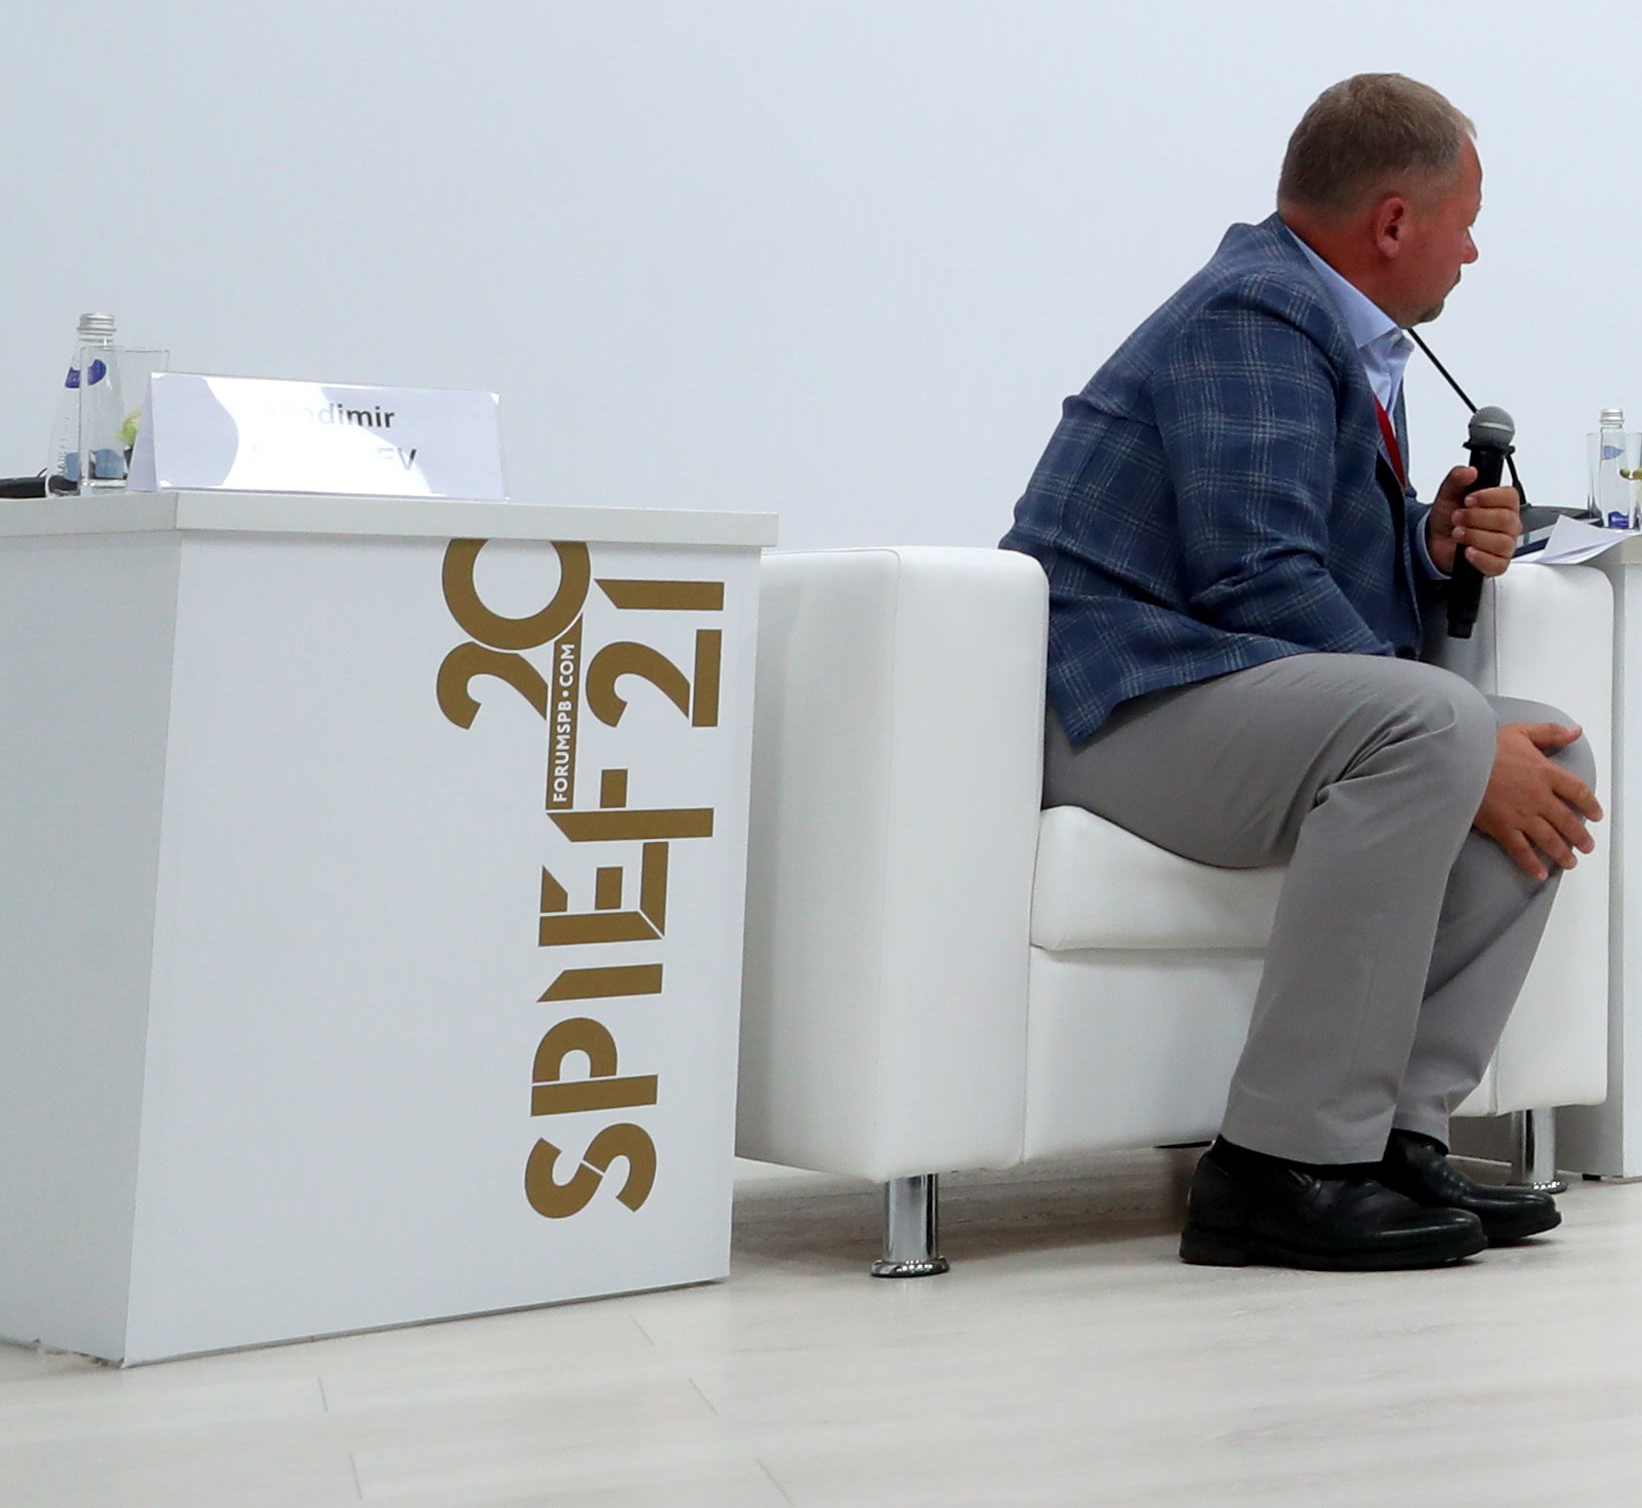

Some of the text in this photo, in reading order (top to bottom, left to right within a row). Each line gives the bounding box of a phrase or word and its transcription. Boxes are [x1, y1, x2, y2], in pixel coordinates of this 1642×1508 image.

[265, 397, 396, 429] adimir
[525, 578, 725, 1219] SPIEF 21
